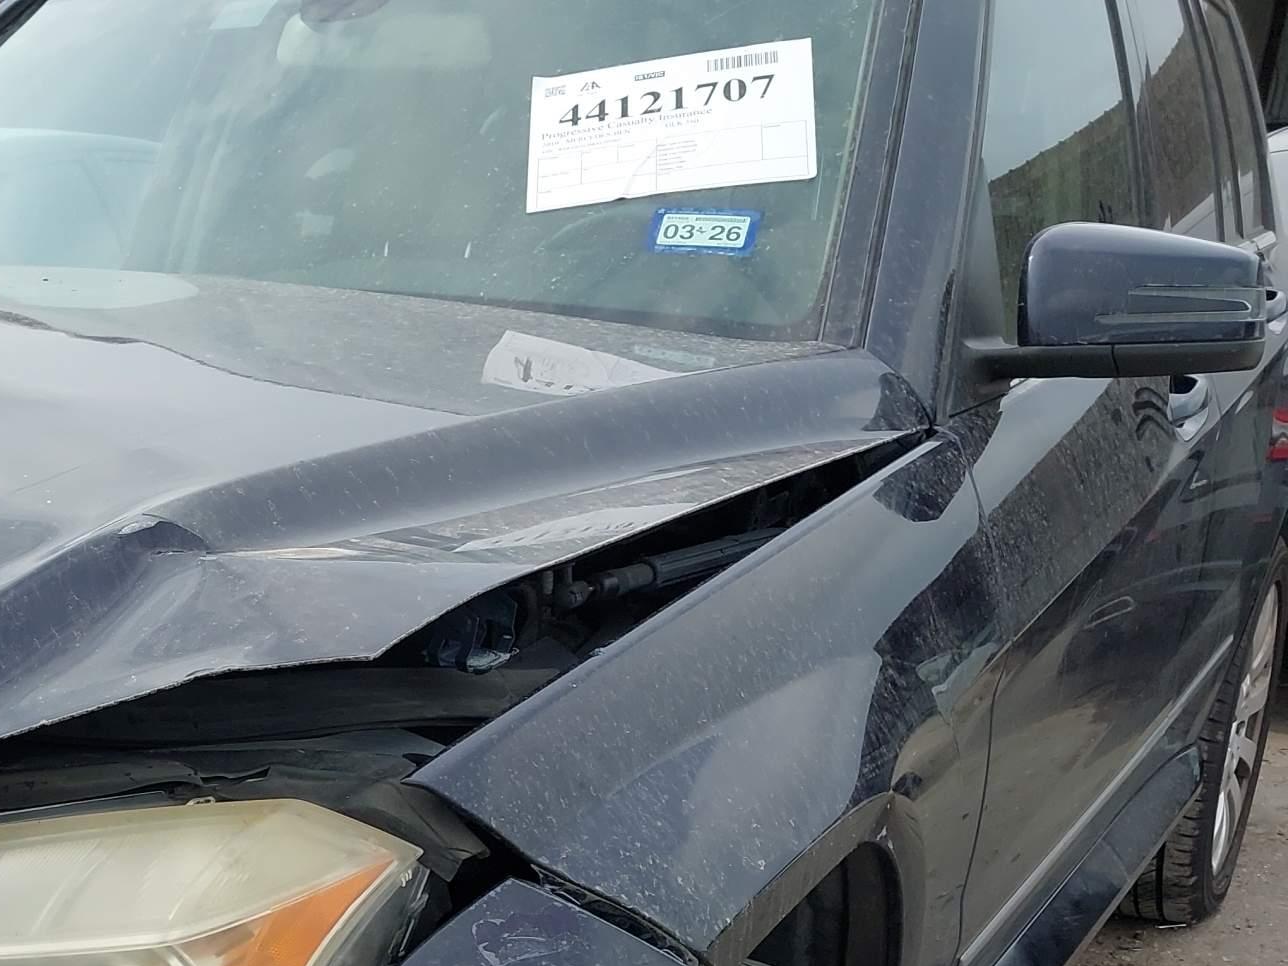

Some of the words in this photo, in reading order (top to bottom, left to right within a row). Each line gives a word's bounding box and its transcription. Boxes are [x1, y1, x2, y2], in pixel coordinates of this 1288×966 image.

[558, 74, 775, 126] 44121707
[663, 224, 695, 240] 03
[708, 225, 743, 242] 26
